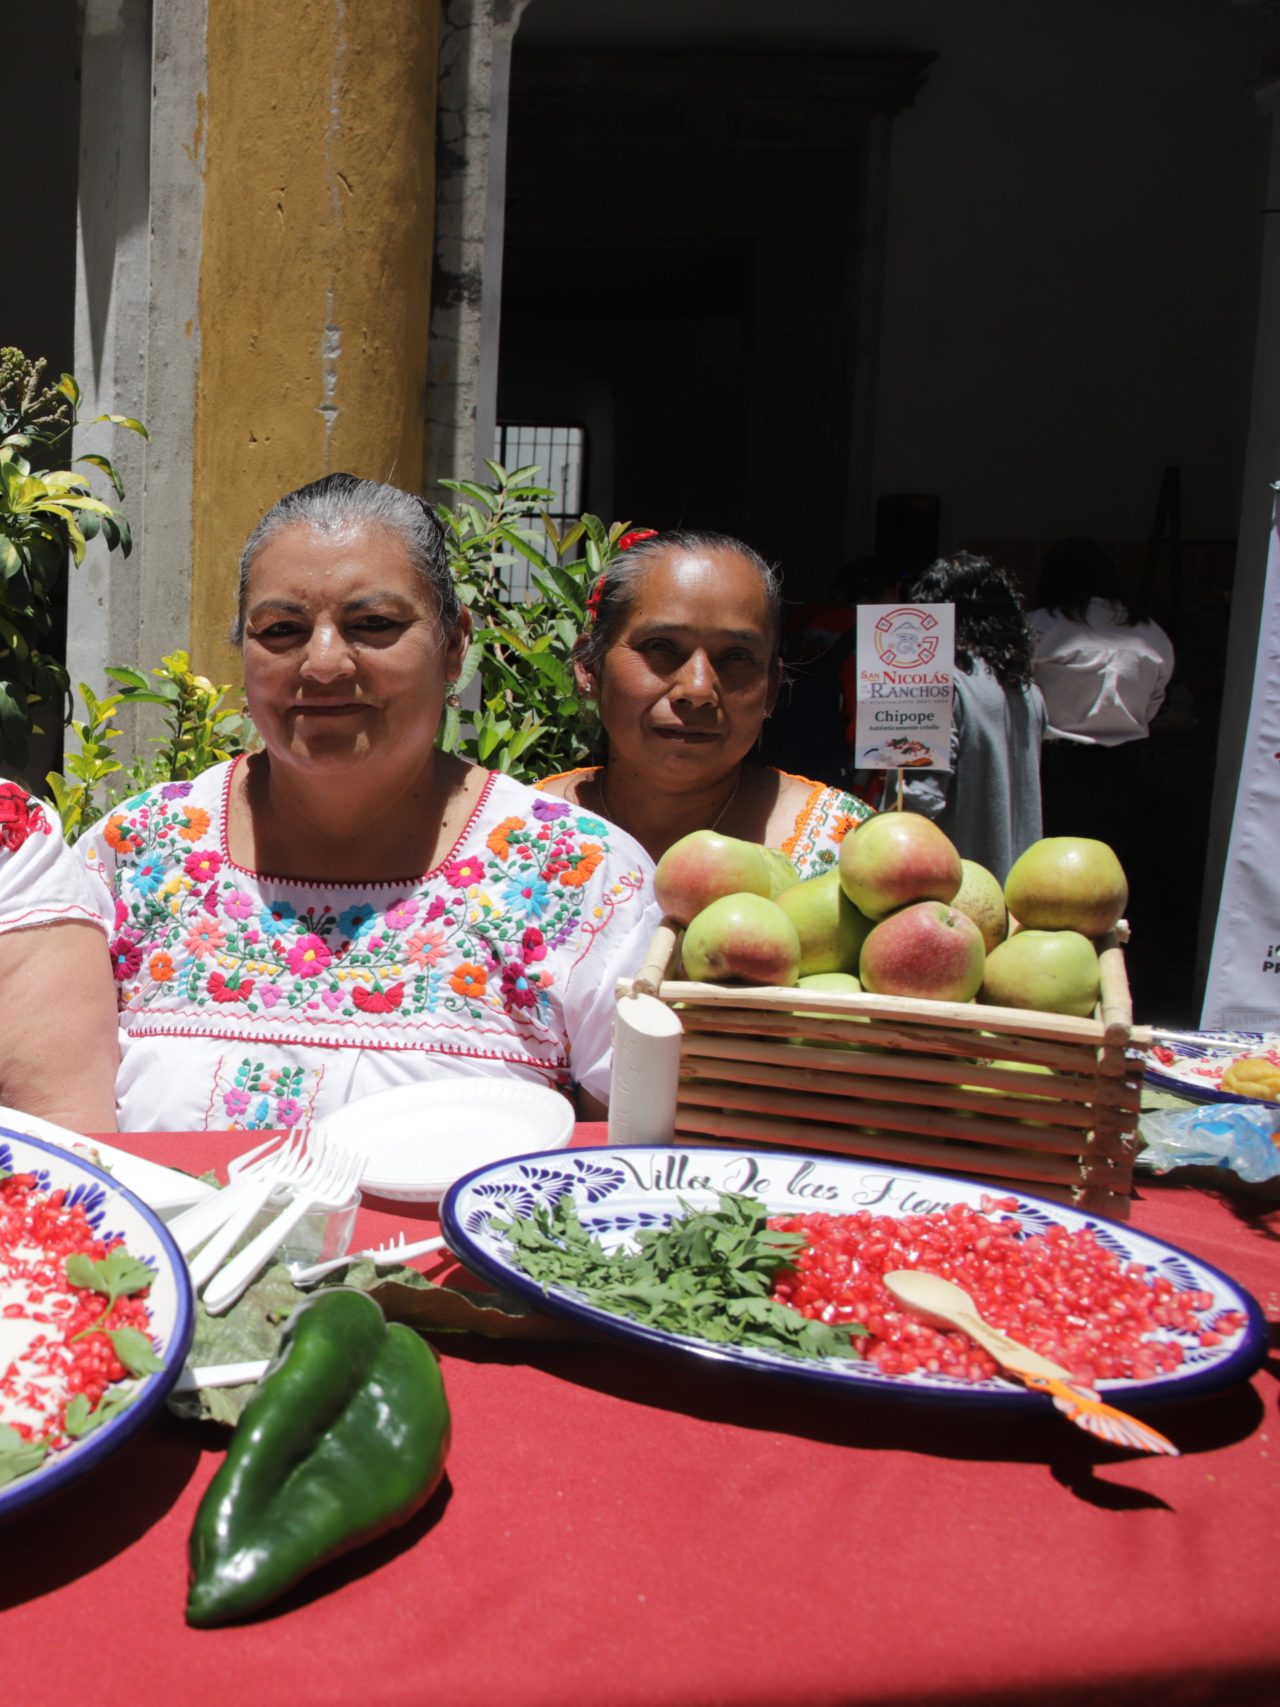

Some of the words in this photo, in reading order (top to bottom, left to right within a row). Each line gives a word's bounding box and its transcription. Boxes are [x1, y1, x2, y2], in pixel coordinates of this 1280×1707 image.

[883, 671, 948, 684] NICOLÁS
[871, 683, 950, 698] RANCHOS
[875, 710, 934, 725] Chipope
[611, 1154, 711, 1192] Villa
[786, 1160, 839, 1201] las
[852, 1174, 951, 1215] Flor
